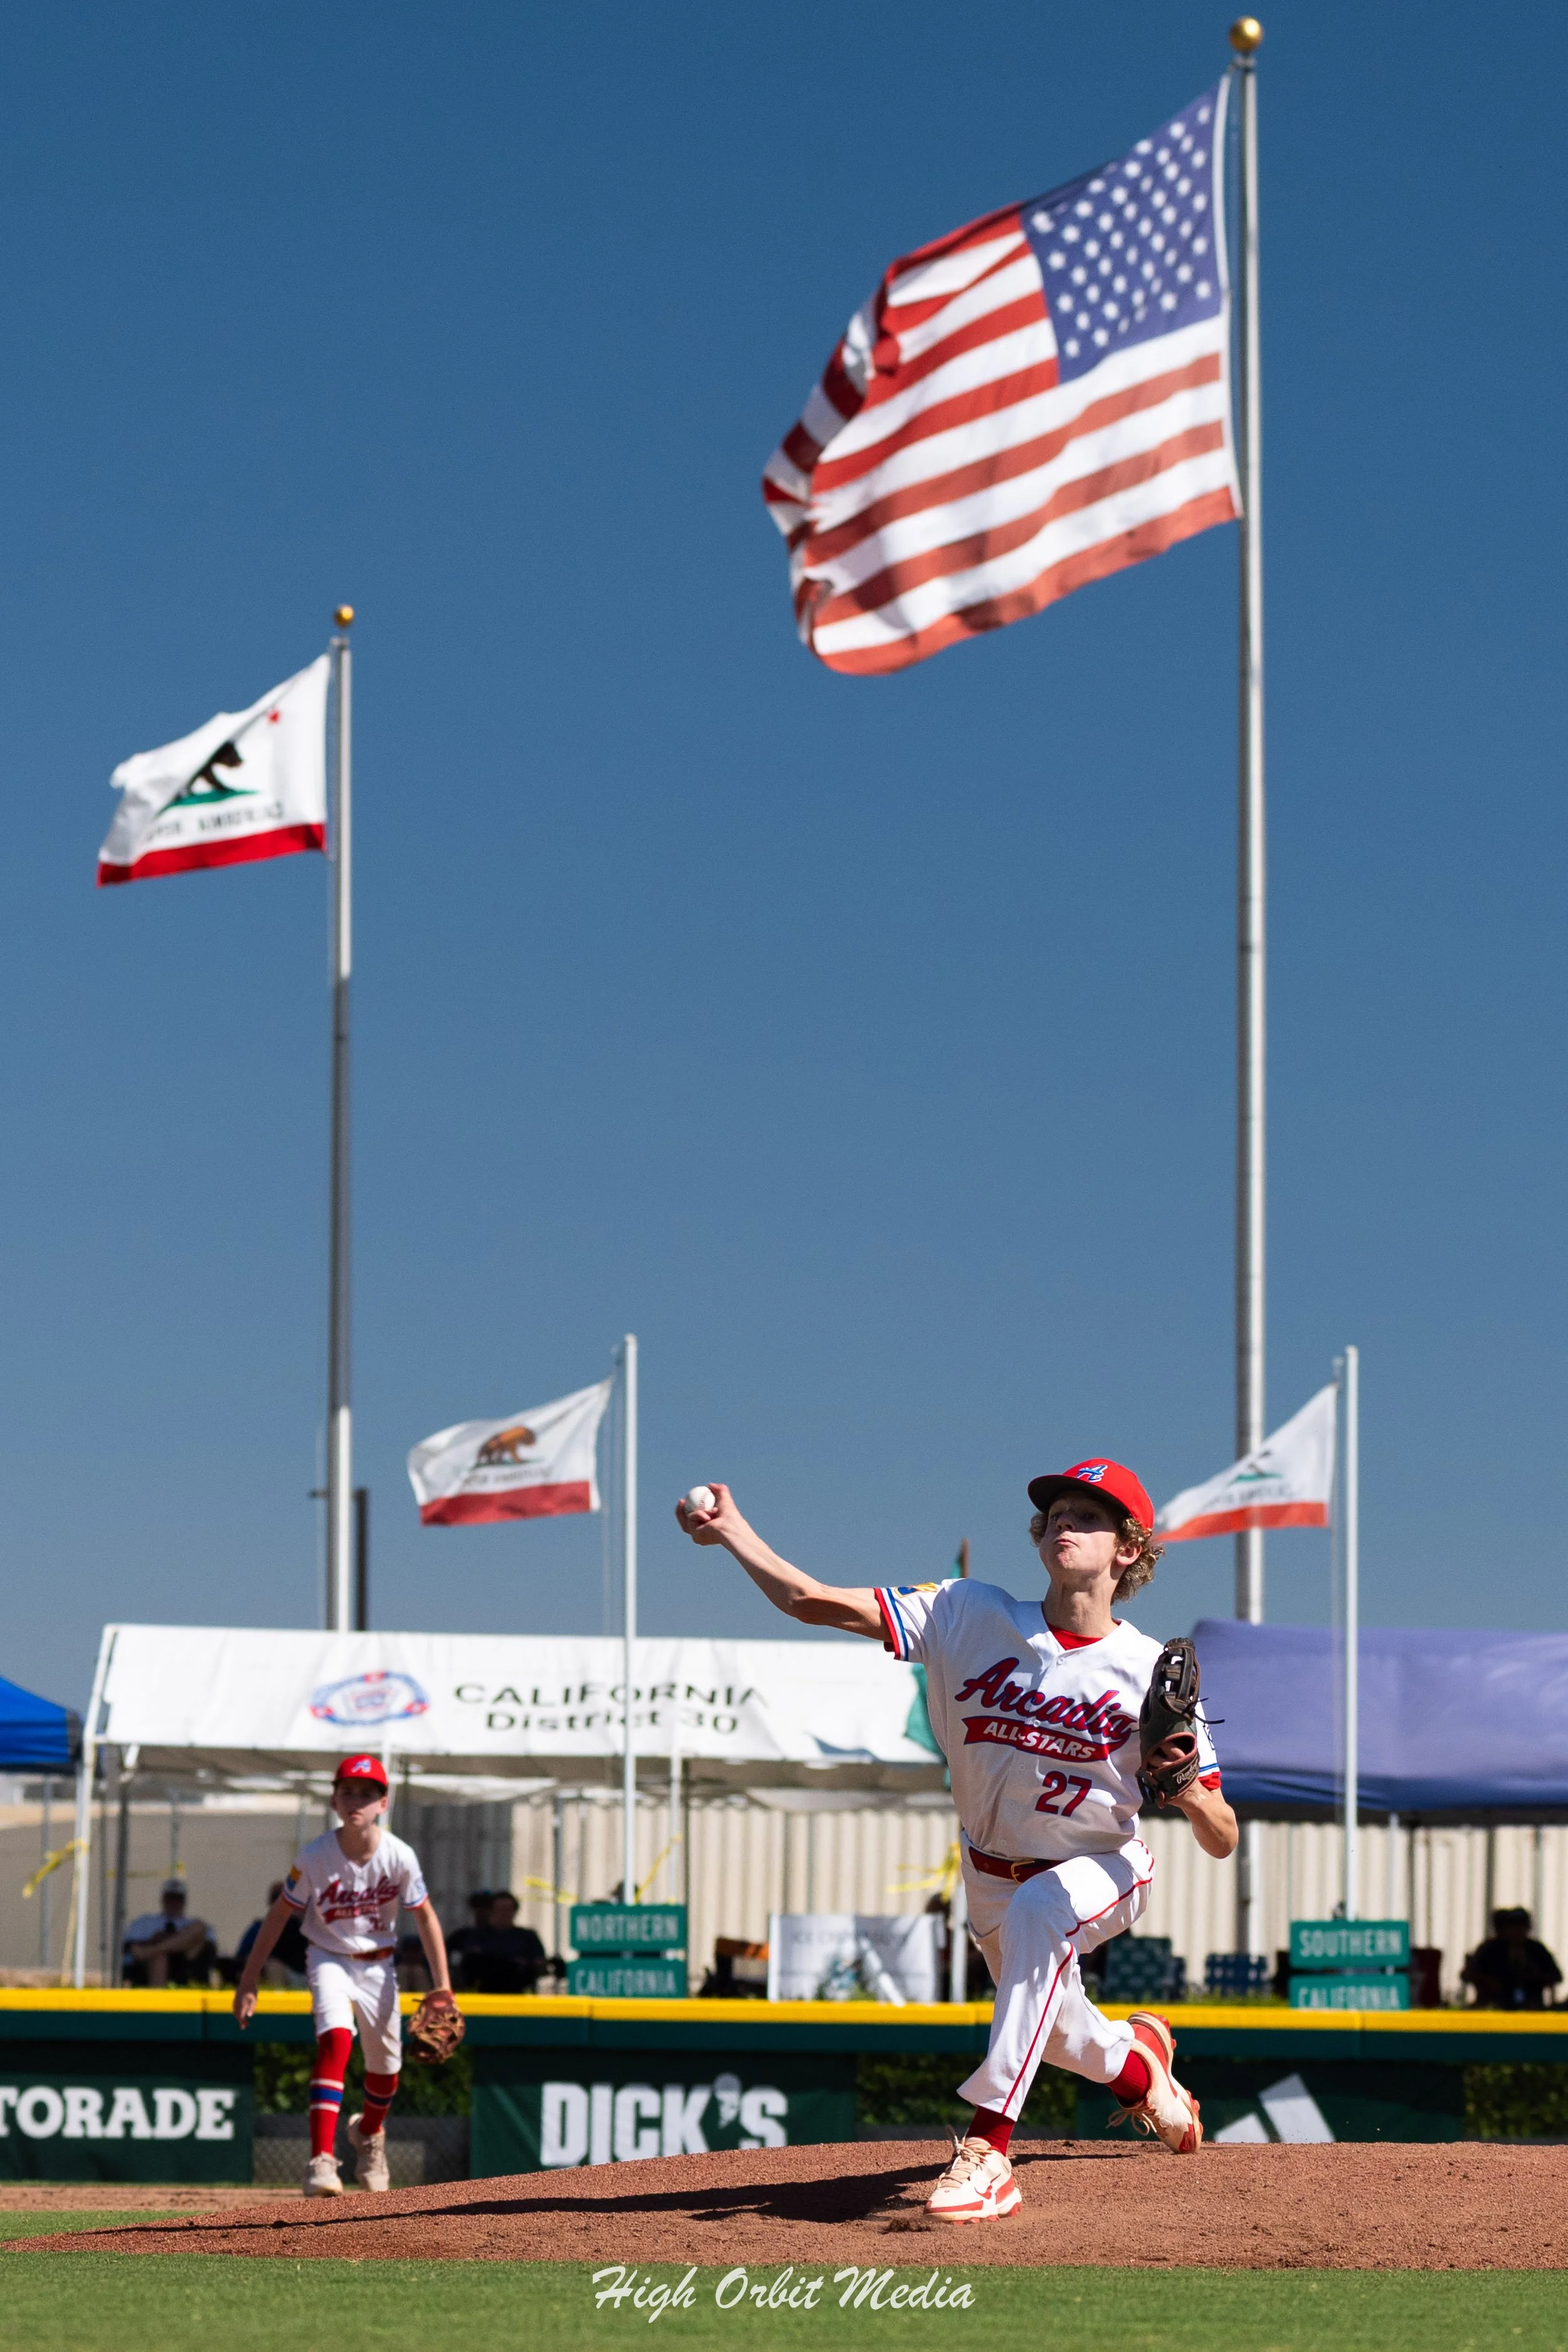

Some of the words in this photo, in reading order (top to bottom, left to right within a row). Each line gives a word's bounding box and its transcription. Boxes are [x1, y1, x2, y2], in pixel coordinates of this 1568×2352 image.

[1076, 1465, 1108, 1483] A
[456, 1682, 770, 1709] CALIFORNIA
[955, 1657, 1137, 1741] Arcadia
[486, 1710, 661, 1731] District
[680, 1707, 739, 1735] 30
[983, 1722, 1096, 1759] ALL-STARS
[1035, 1771, 1093, 1817] 27
[576, 1915, 678, 1941] NORTHERN
[1300, 1929, 1402, 1957] SOUTHERN
[576, 1969, 676, 1995] CALIFORNIA
[1298, 1986, 1400, 2010] CALIFORNIA
[540, 2073, 788, 2166] DICK'S
